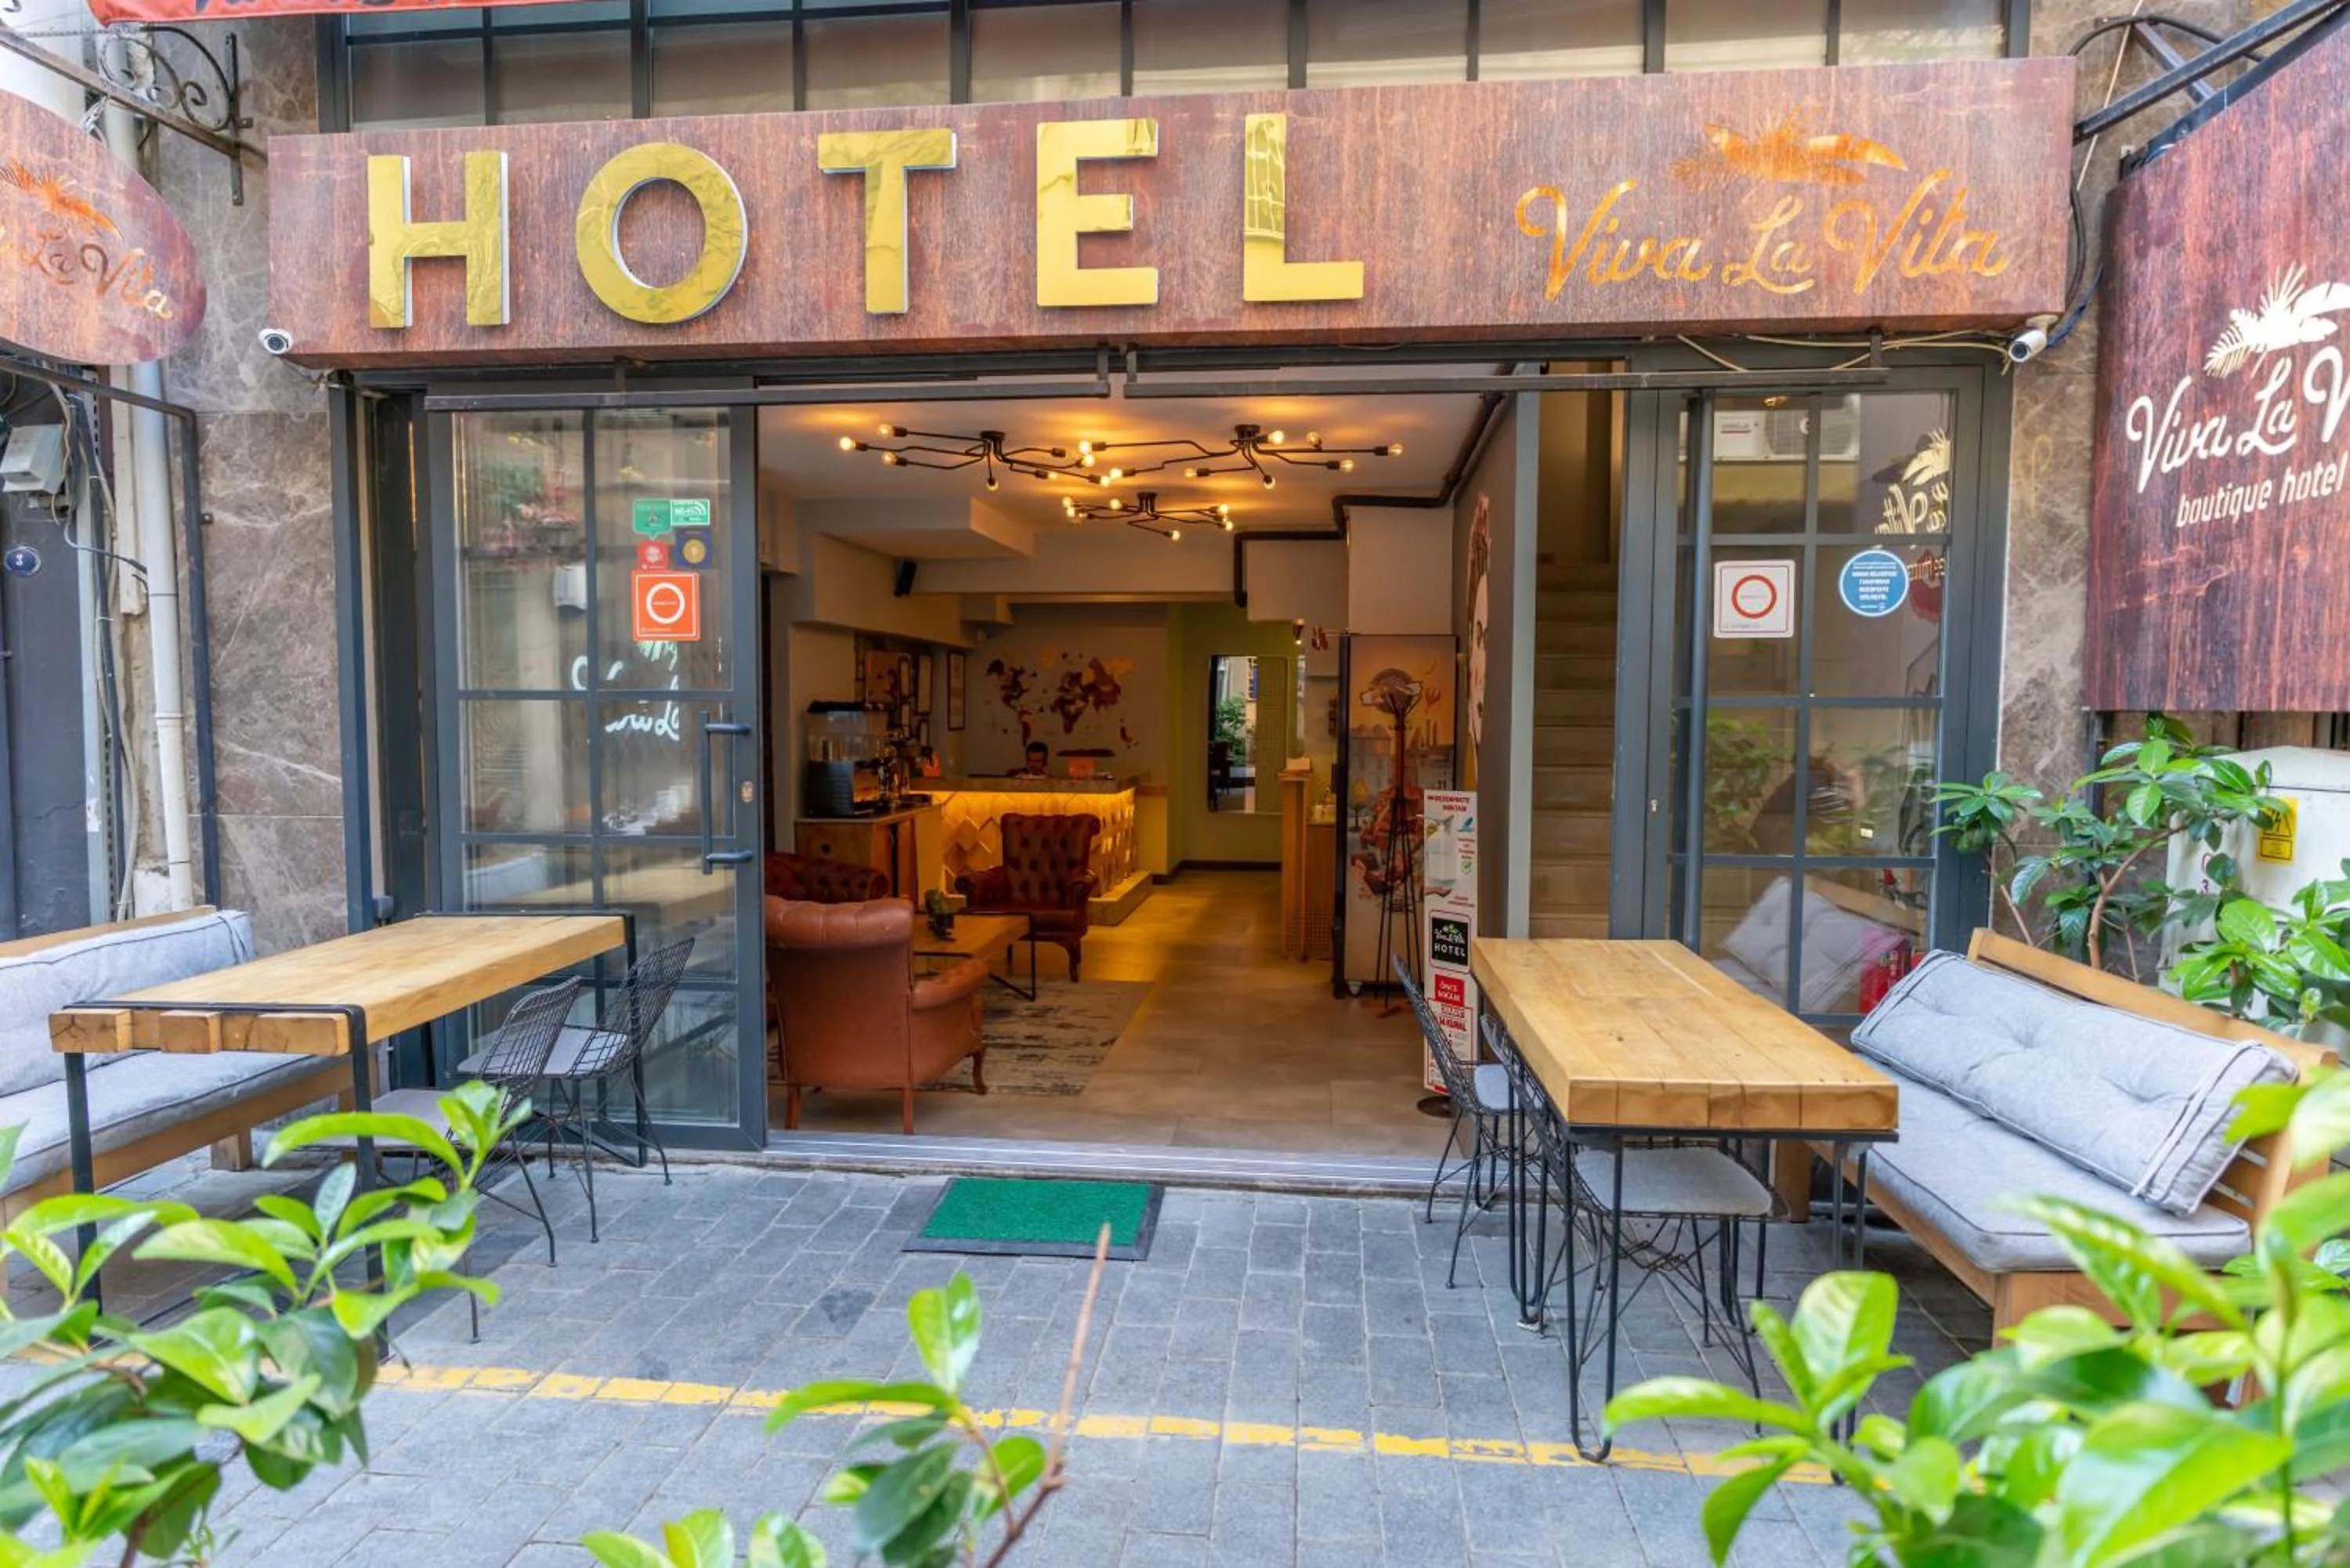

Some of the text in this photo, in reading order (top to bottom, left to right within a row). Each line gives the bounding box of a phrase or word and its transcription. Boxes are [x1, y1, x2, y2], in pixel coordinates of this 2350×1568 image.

[367, 112, 1365, 328] HOTEL
[1515, 168, 2008, 302] Viva La Vita
[80, 242, 173, 320] Vita
[2125, 345, 2350, 493] Viva La V
[2175, 450, 2348, 528] boutique hotel
[1434, 942, 1466, 957] HOTEL
